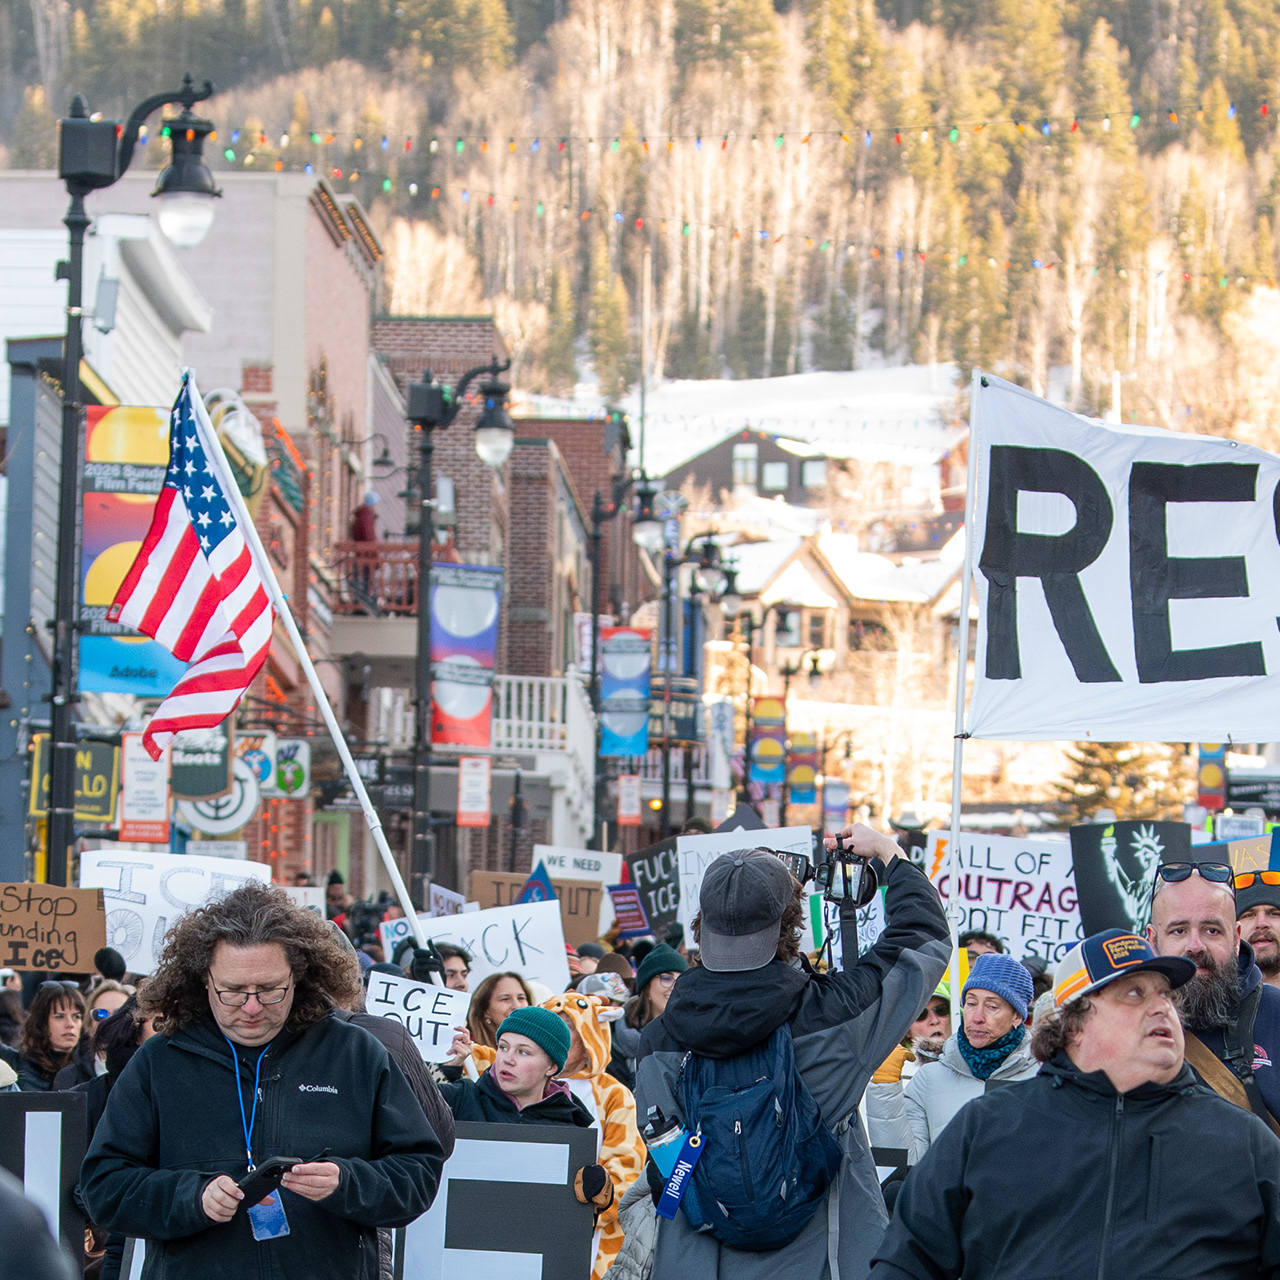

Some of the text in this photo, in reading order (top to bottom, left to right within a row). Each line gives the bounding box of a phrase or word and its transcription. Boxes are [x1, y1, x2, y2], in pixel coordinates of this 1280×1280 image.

[84, 463, 120, 478] 2026
[94, 477, 125, 491] Film
[81, 607, 110, 621] 202
[109, 665, 158, 680] Adobe
[171, 750, 222, 767] Roots
[546, 854, 602, 873] WE NEED
[632, 848, 679, 888] FUCK
[1014, 851, 1053, 876] OF
[0, 885, 78, 932] Stop
[647, 881, 679, 918] ICE
[383, 920, 409, 940] NO
[1021, 913, 1070, 941] FIT
[428, 916, 545, 967] CK
[375, 980, 454, 1016] ICE
[306, 1085, 339, 1095] Columbia
[665, 1159, 693, 1200] Newell
